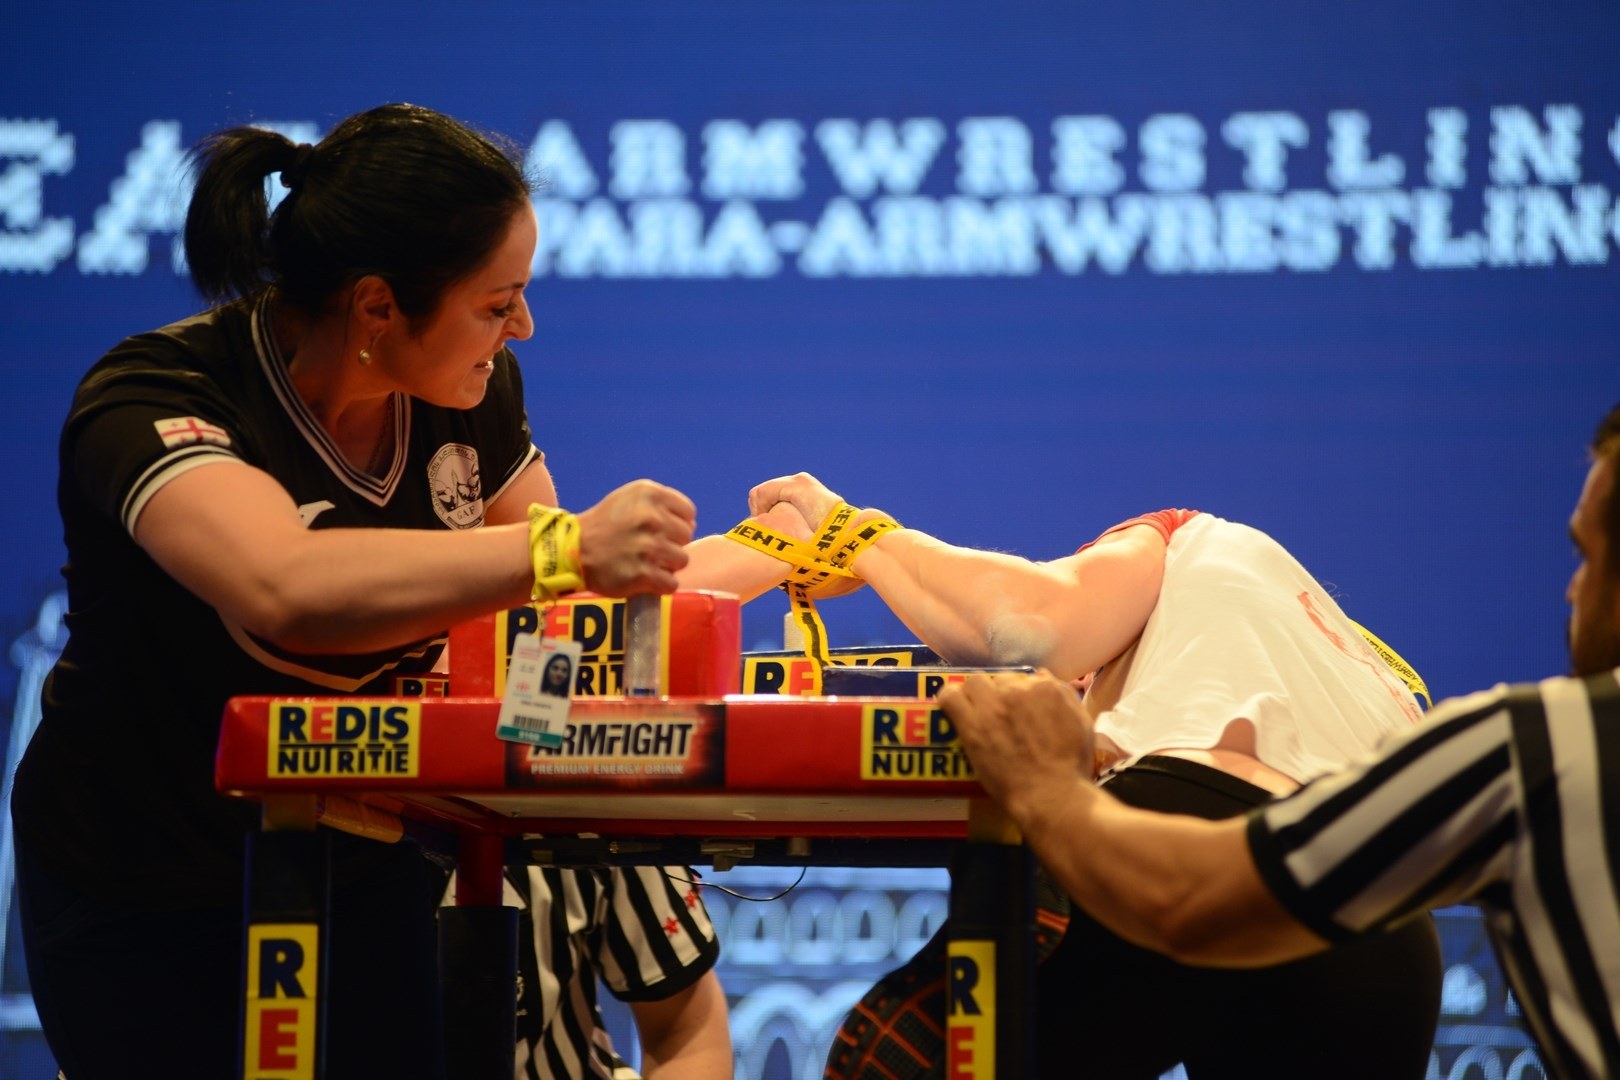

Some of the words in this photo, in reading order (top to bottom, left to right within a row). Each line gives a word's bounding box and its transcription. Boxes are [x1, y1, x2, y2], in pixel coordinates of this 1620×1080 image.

[524, 103, 1620, 198] ARMWRESTLIN
[528, 183, 1620, 278] PARA-ARMWRESTLIN
[279, 705, 409, 744] REDIS
[533, 722, 693, 757] RMFIGHT
[277, 742, 409, 774] NUTRITIE
[531, 764, 589, 775] PREMIUM
[593, 764, 640, 775] ENERGY
[645, 764, 685, 775] DRINK
